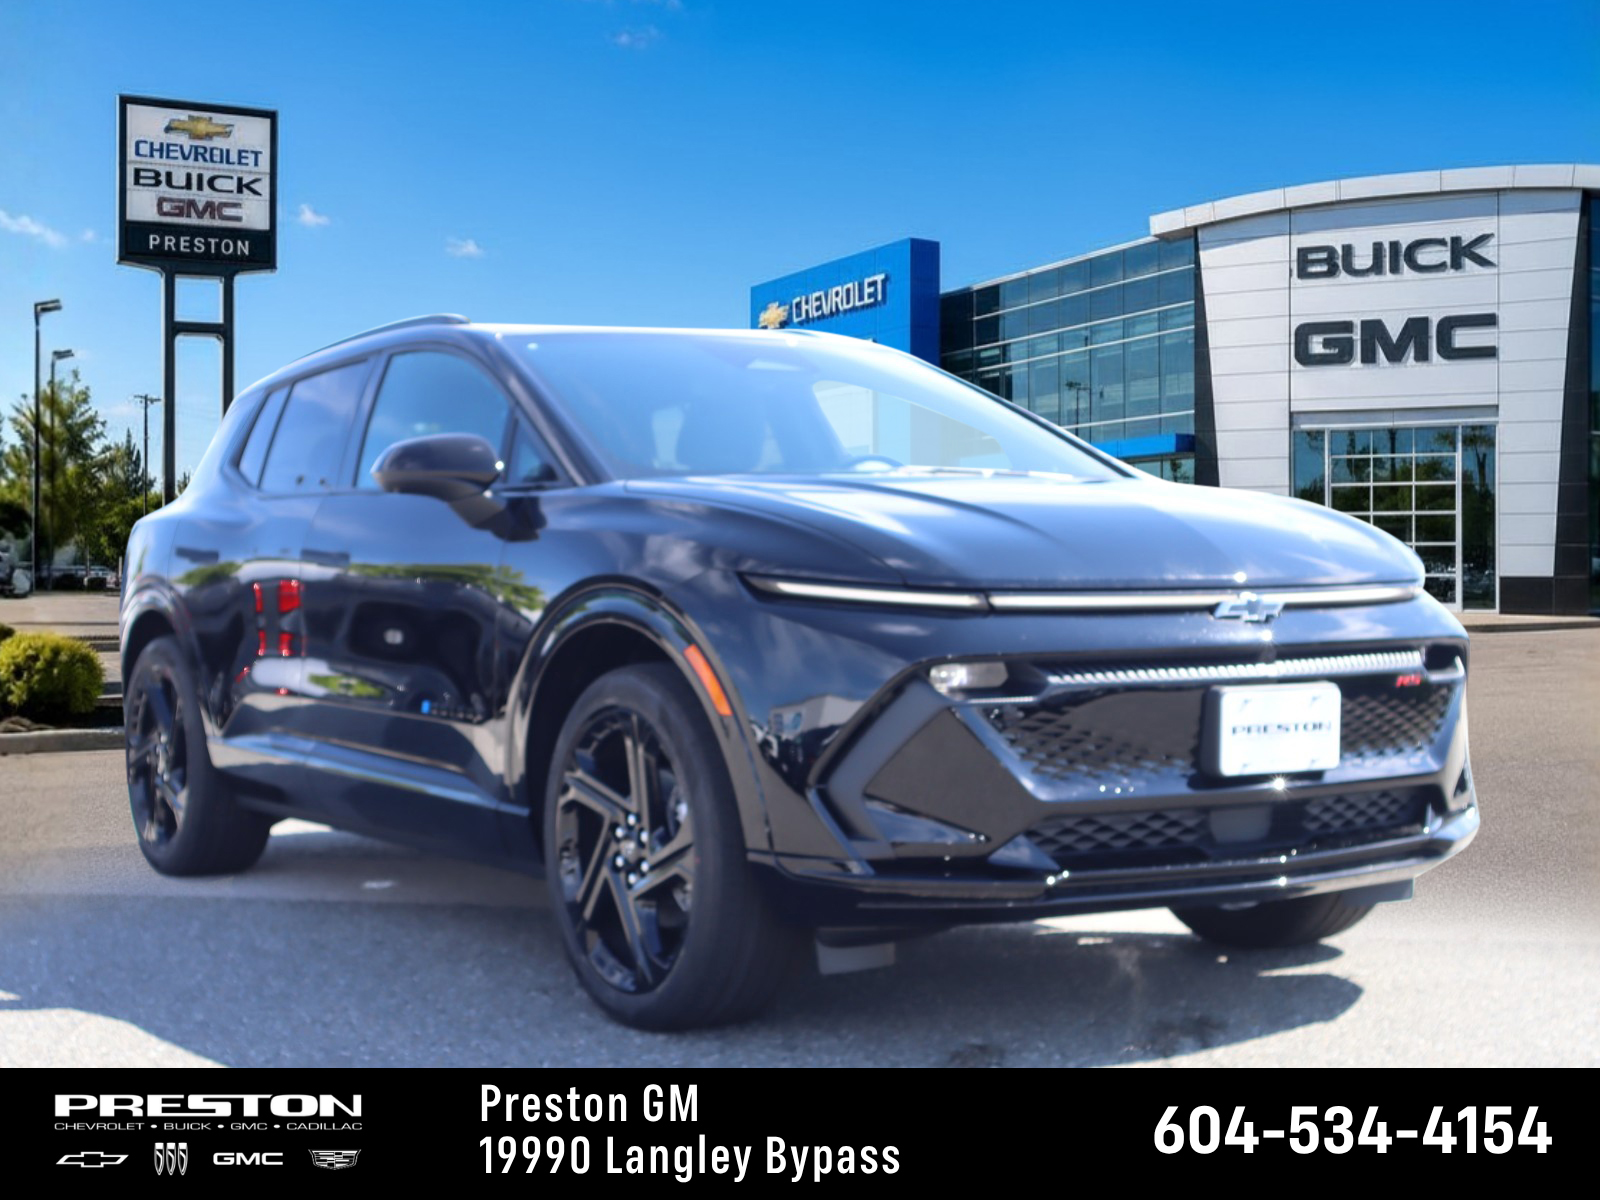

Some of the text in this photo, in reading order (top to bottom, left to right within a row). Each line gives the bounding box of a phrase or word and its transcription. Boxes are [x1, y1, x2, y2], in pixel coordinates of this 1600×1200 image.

[134, 140, 263, 167] CHEVROLET
[133, 168, 262, 197] BUICK
[157, 196, 243, 222] GMC
[149, 235, 249, 256] PRESTON
[1297, 233, 1497, 280] BUICK
[792, 273, 886, 323] CHEVROLET
[1294, 313, 1498, 367] GMC
[1231, 721, 1332, 736] PRESTON
